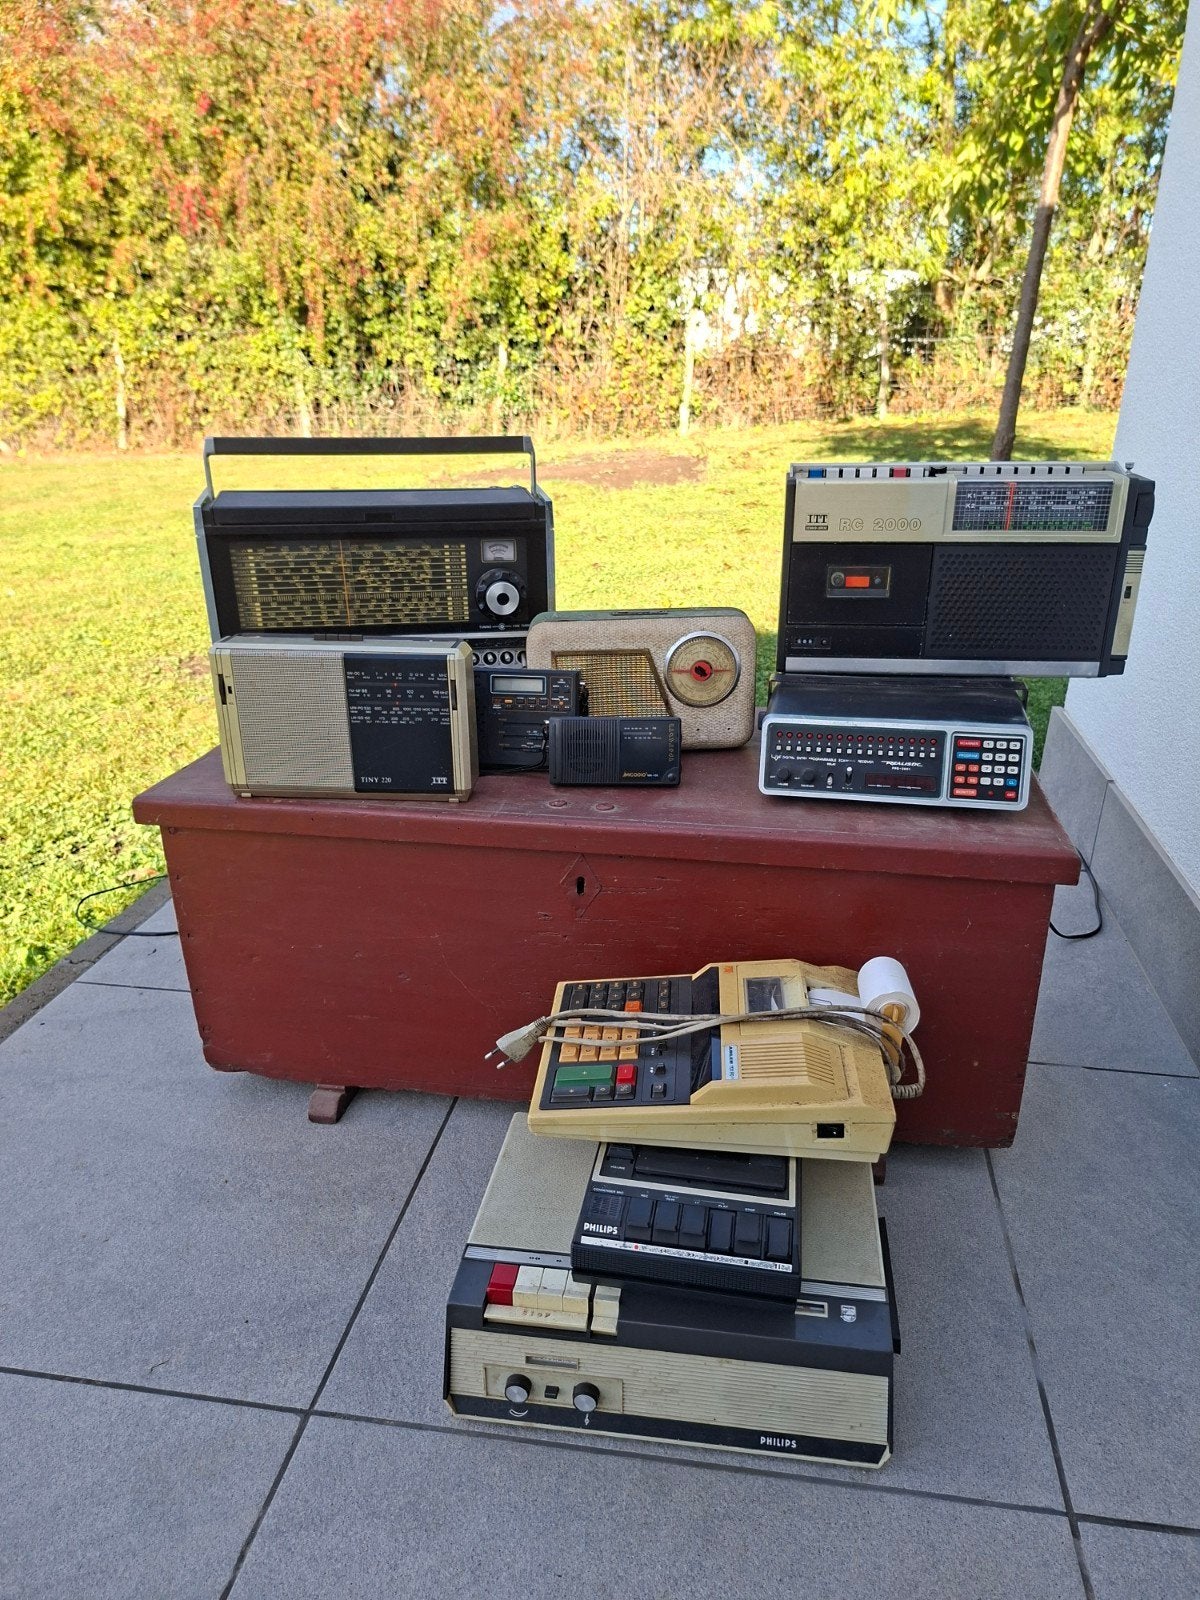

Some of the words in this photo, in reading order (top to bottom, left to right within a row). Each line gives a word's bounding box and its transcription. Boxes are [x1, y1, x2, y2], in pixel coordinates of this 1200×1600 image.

[807, 514, 828, 524] ITT
[839, 518, 864, 531] RC
[872, 518, 922, 532] 2000
[583, 1222, 618, 1235] PHILIPS
[760, 1436, 798, 1448] PHILIPS
